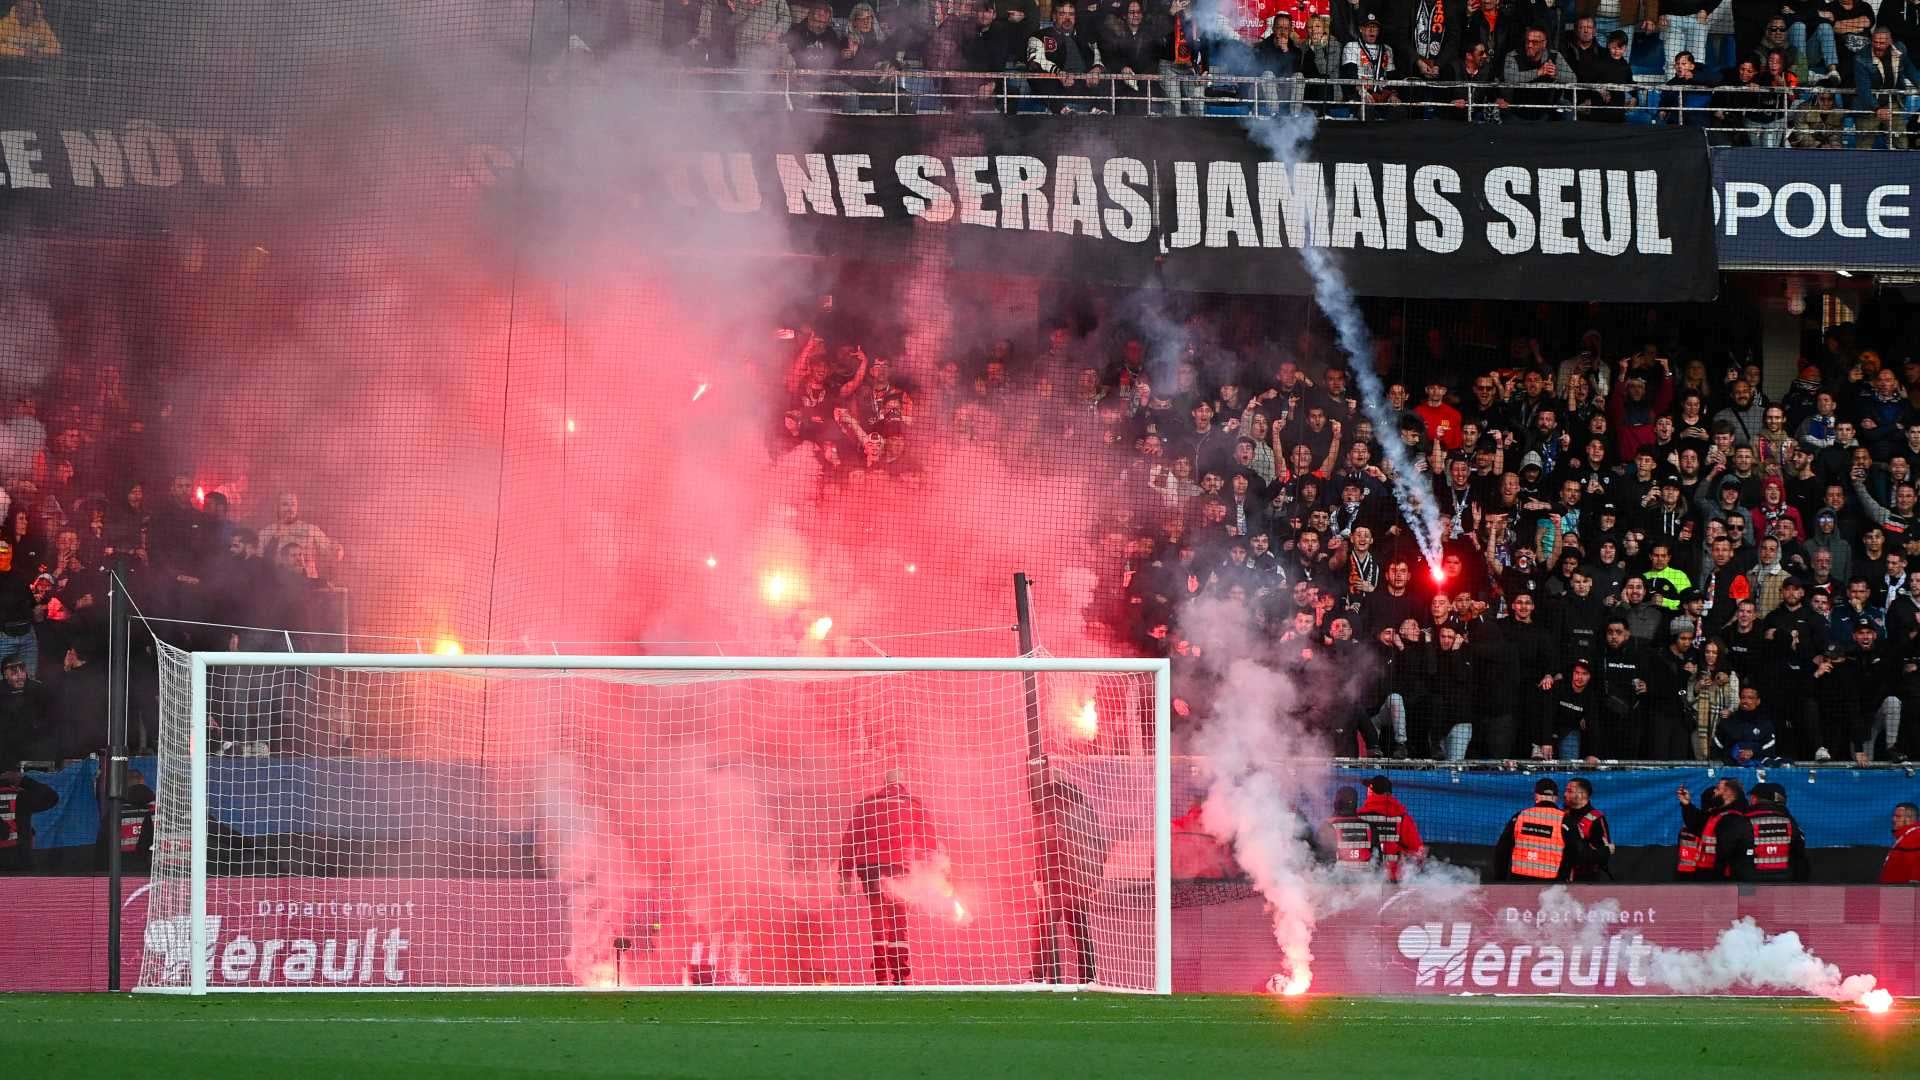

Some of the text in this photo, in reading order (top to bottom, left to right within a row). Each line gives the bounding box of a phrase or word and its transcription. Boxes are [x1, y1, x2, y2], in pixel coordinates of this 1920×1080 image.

[0, 129, 52, 188] E
[776, 153, 885, 218] NE
[895, 154, 1152, 243] SERAS
[1170, 160, 1464, 253] JAMAIS
[1484, 165, 1672, 256] SEUL
[1712, 182, 1910, 238] POLE
